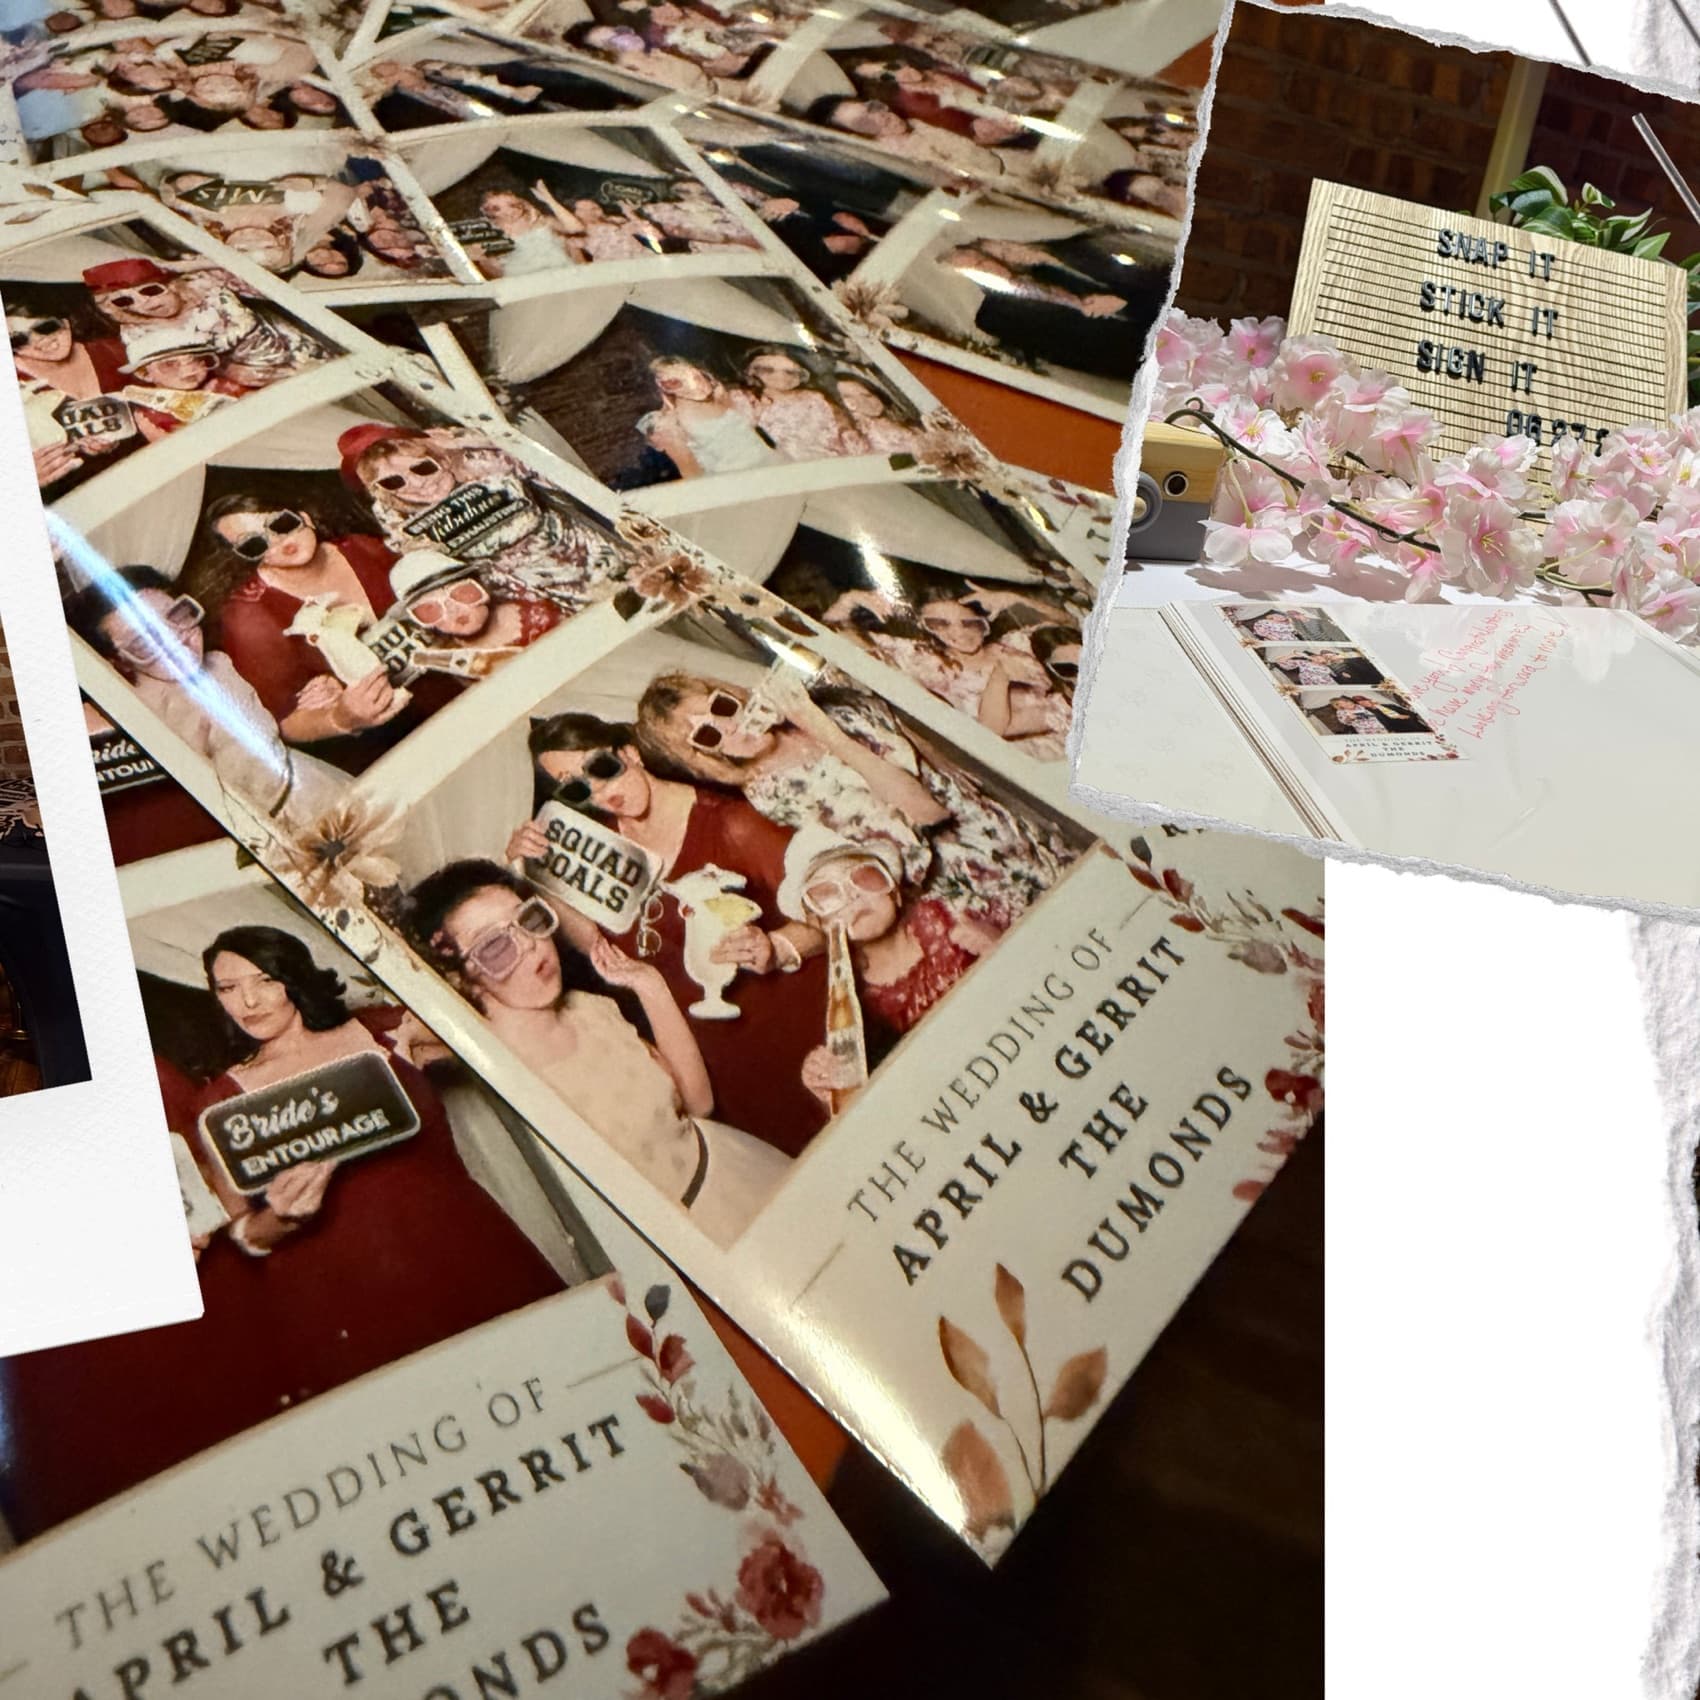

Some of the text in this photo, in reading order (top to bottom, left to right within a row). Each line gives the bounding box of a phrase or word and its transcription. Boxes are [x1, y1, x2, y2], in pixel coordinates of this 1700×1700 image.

[1437, 227, 1556, 282] SNAP IT
[1420, 280, 1559, 340] STICK IT
[1416, 339, 1538, 395] SIGN IT
[544, 818, 643, 888] SQUAD
[223, 1086, 339, 1150] Bride's
[846, 926, 1118, 1223] THE WEDDING OF
[892, 935, 1186, 1286] APRIL & GERRIT
[240, 1107, 391, 1177] ENTOURAGE
[1059, 1081, 1149, 1179] THE
[1061, 1066, 1253, 1303] DUMONDS
[54, 1376, 547, 1650] THE WEDDING OF
[321, 1549, 365, 1598] &
[389, 1413, 628, 1557] GERRIT
[322, 1579, 470, 1687] THE
[421, 1603, 611, 1700] NDS
